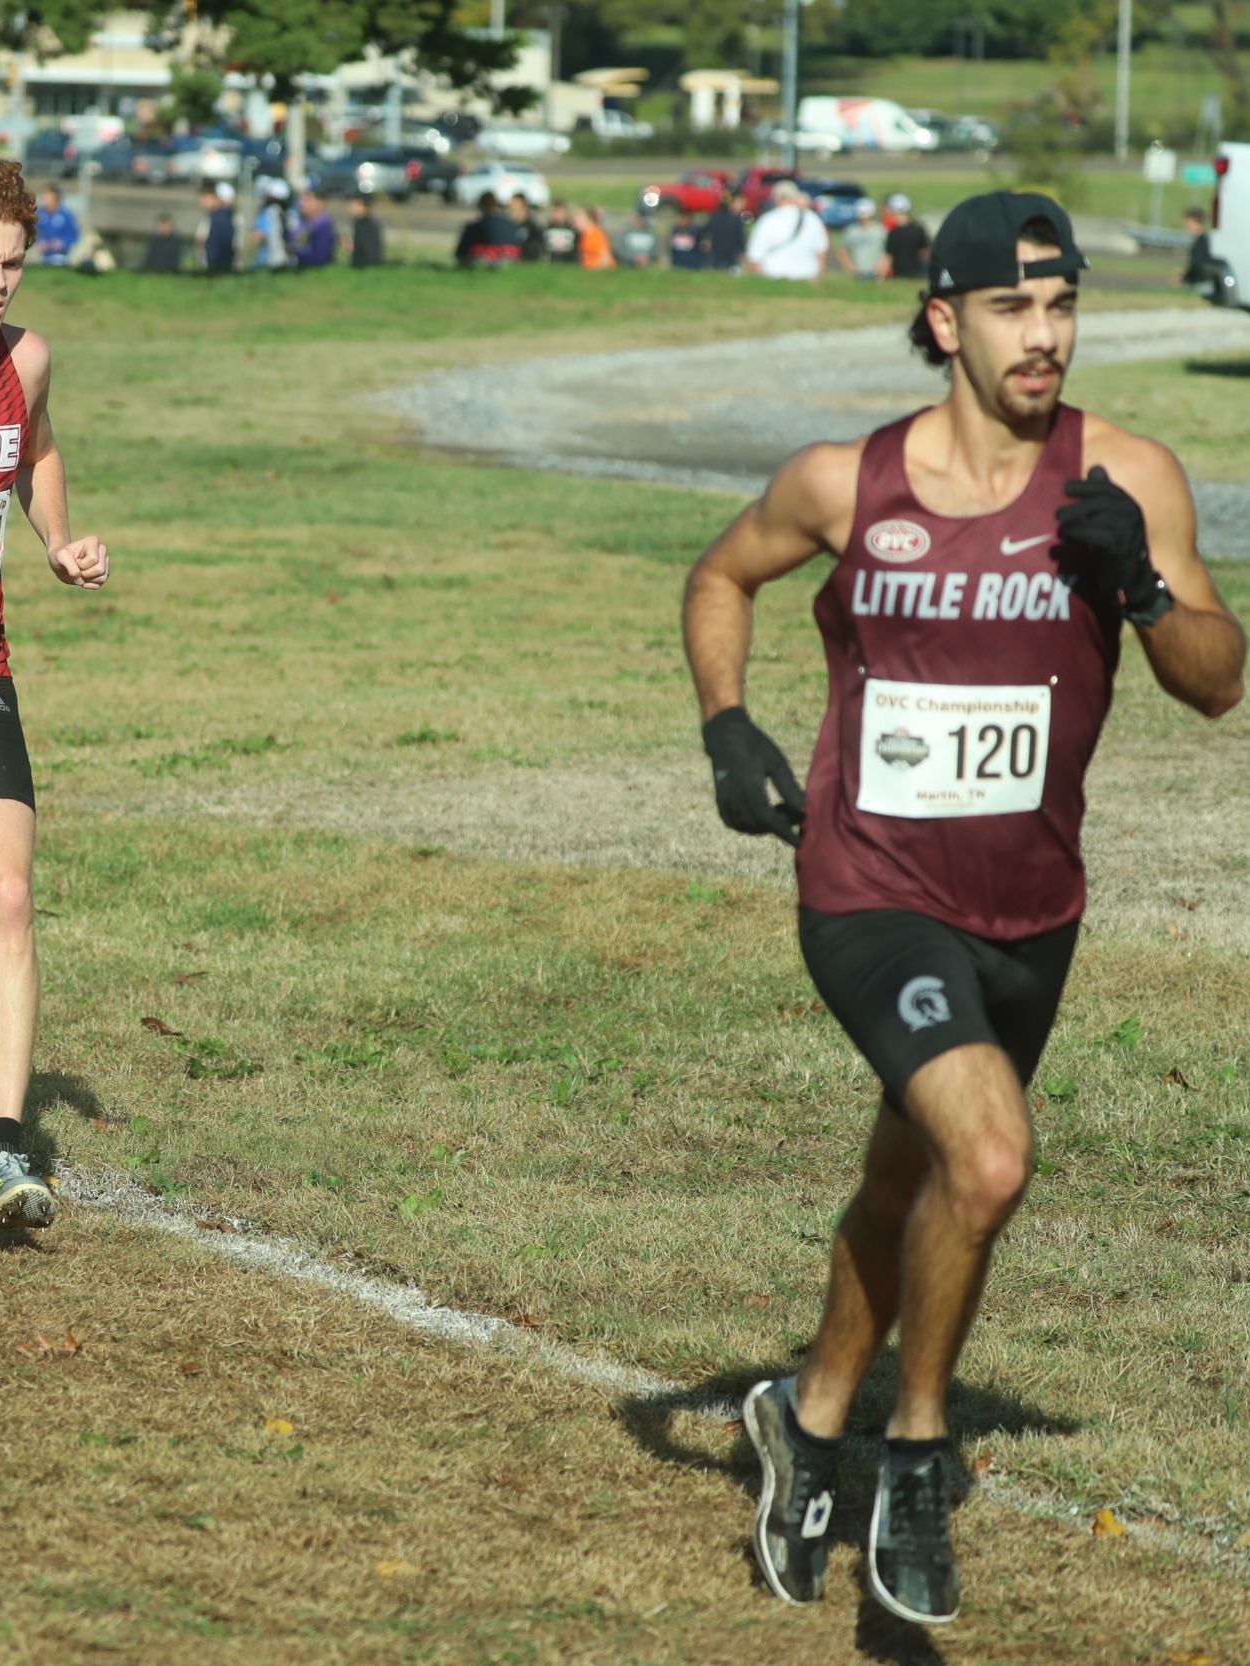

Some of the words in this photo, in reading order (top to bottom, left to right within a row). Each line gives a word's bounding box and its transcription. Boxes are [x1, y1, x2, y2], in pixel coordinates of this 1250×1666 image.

[851, 569, 968, 619] LITTLE
[972, 571, 1071, 621] ROCK
[876, 694, 910, 710] OVC
[917, 696, 1040, 715] Championship
[948, 724, 1038, 780] 120
[968, 788, 986, 799] TN
